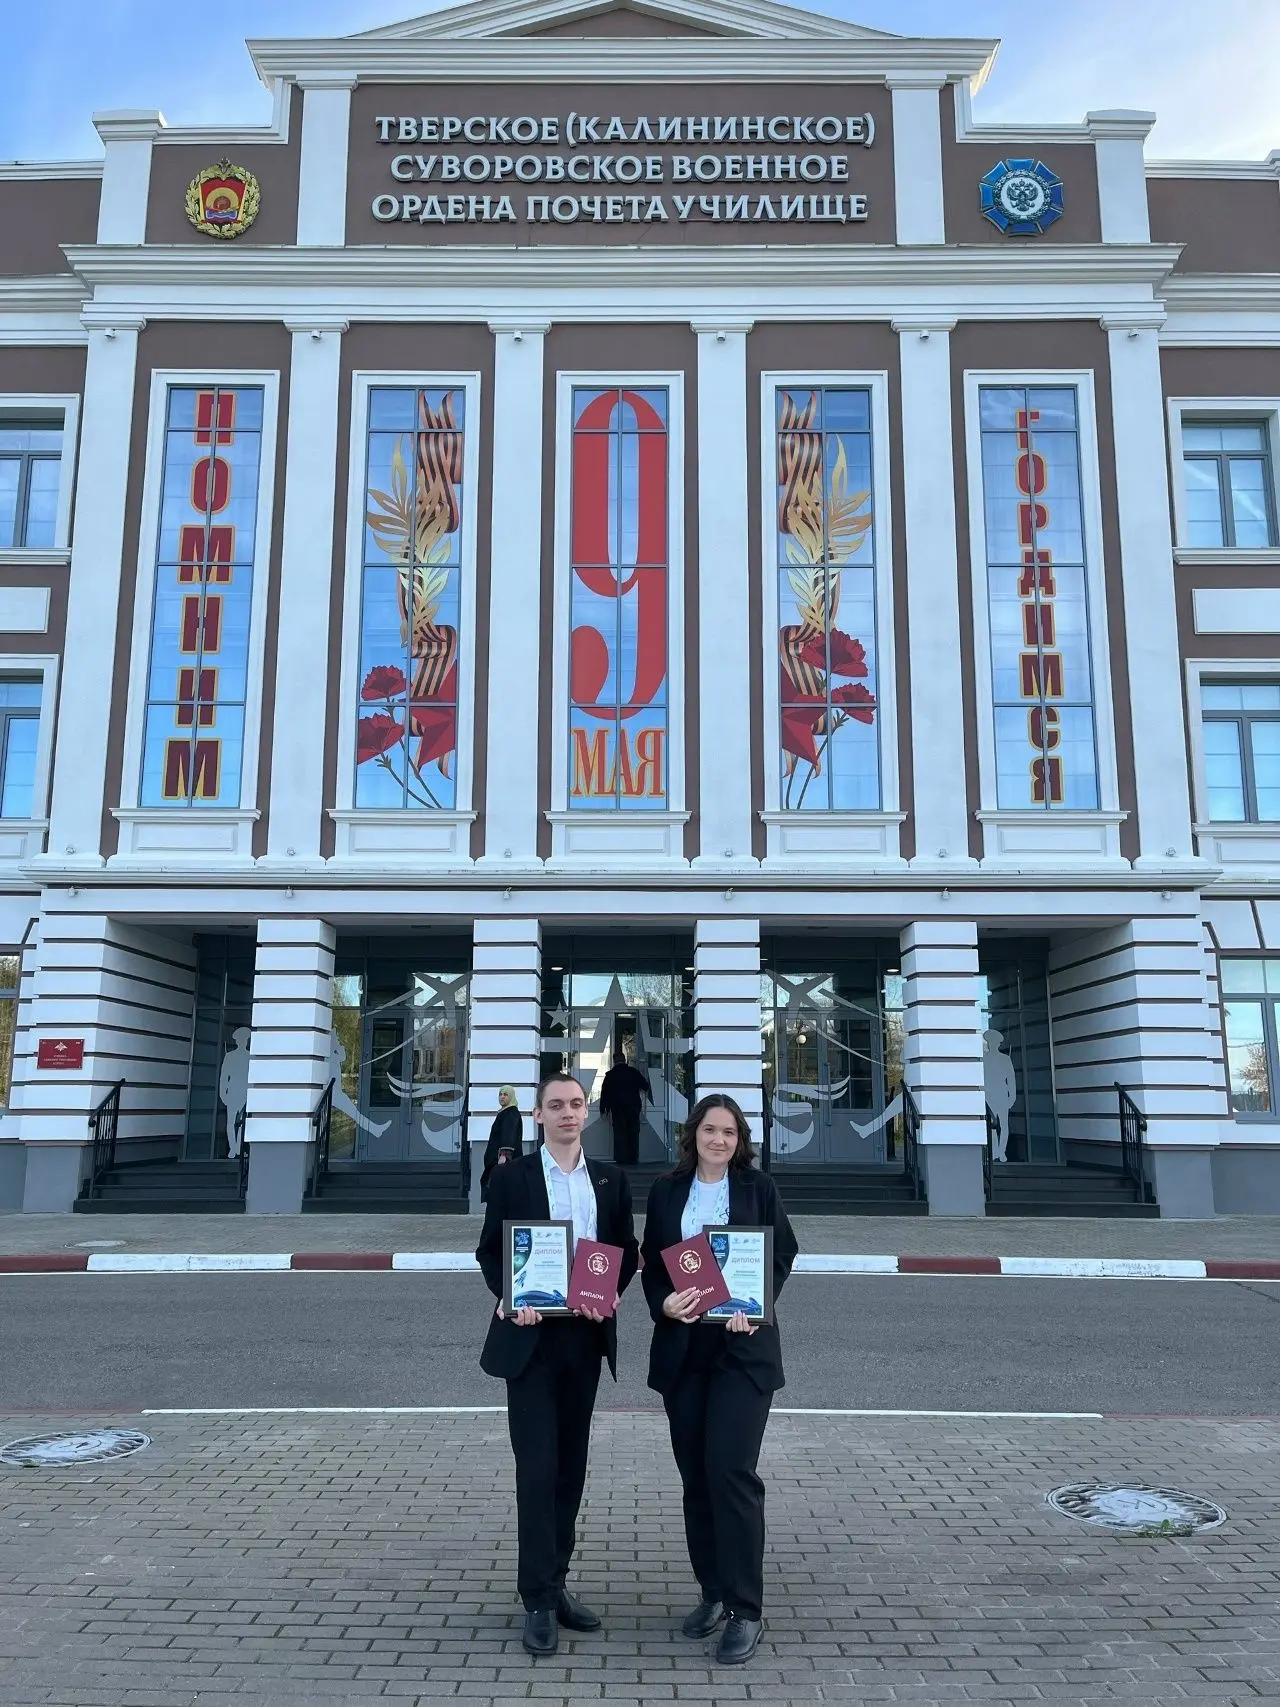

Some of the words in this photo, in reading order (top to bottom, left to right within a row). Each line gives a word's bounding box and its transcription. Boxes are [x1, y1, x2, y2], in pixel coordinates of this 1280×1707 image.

[375, 116, 559, 144] ТВЕРСКОЕ
[566, 111, 876, 148] (КАЛИНИНСКОЕ)
[390, 154, 664, 184] СУВОРОВСКОЕ
[671, 154, 849, 183] ВОЕННОЕ
[371, 194, 518, 225] ОРДЕНА
[526, 195, 669, 224] ПОЧЕТА
[672, 194, 869, 224] УЧИЛИЩЕ
[571, 390, 667, 721] 9
[162, 390, 236, 800] ПОМНИМ
[1014, 409, 1066, 804] ГОРДИМСЯ
[571, 728, 667, 798] МАЯ
[579, 1290, 604, 1301] ДИПЛОМ
